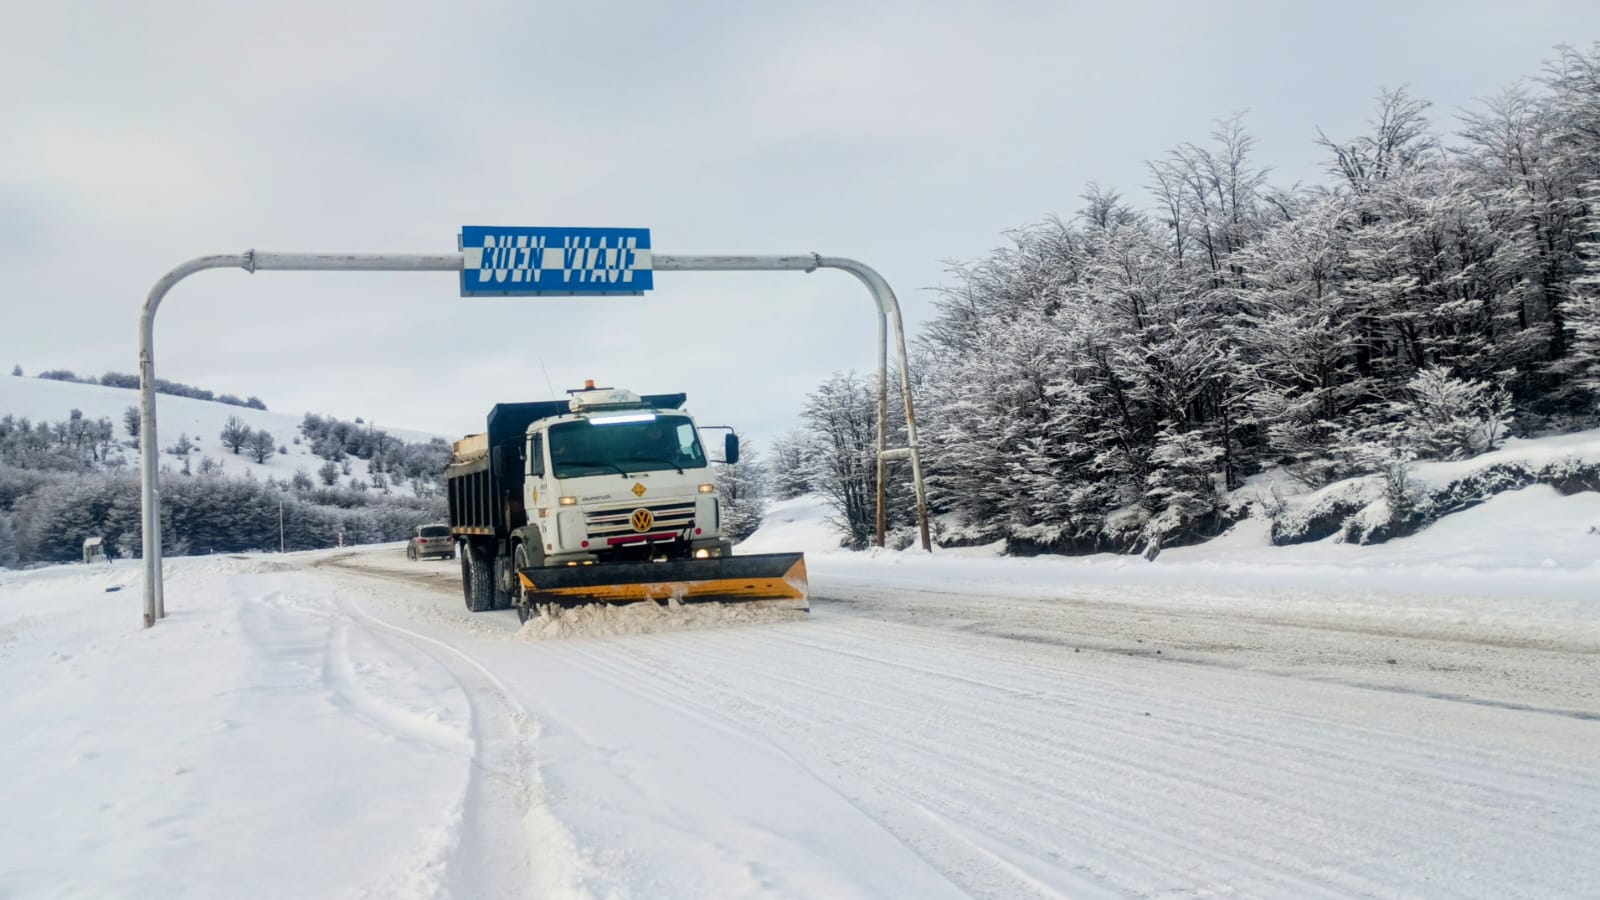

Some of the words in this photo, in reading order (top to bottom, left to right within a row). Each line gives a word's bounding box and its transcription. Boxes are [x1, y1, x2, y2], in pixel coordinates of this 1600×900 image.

[479, 235, 546, 282] BUEN
[563, 236, 637, 283] VIAJE
[632, 509, 653, 531] VW
